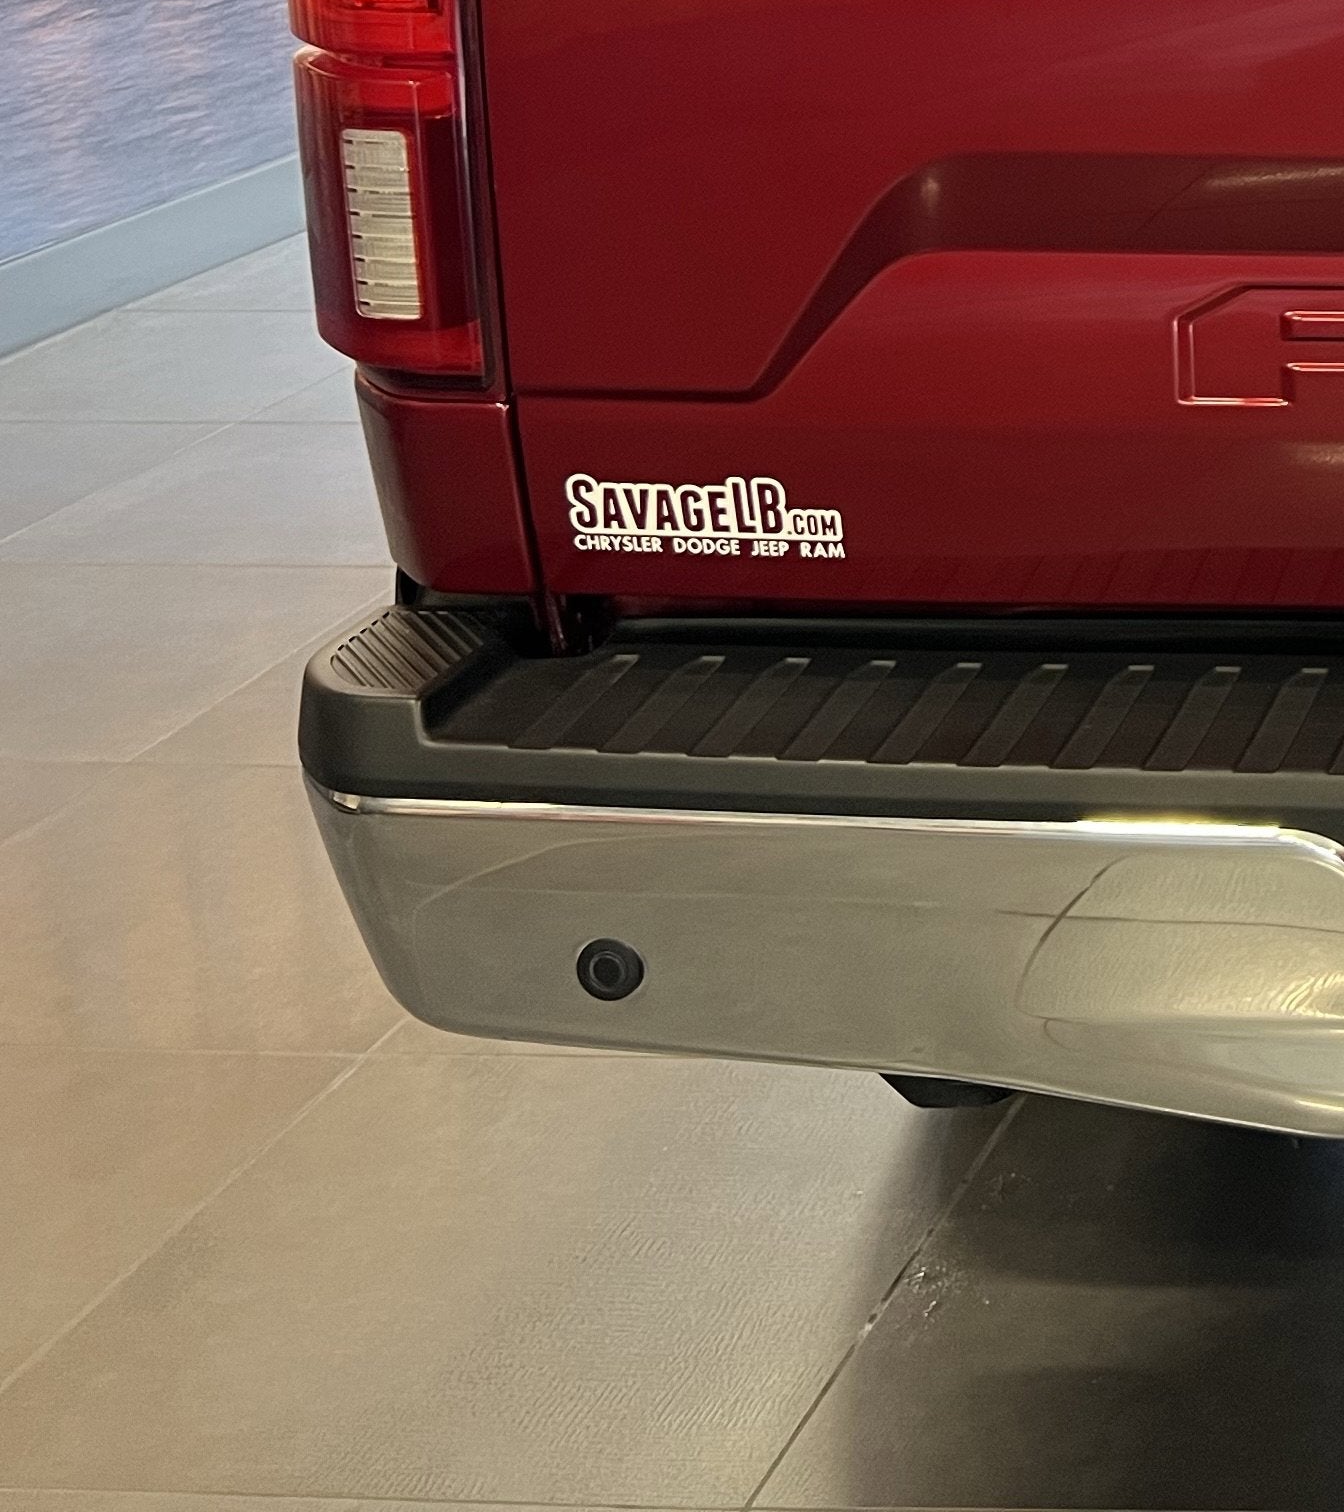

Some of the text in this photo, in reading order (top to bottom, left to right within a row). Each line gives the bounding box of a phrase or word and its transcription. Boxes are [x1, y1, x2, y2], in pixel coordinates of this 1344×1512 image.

[573, 534, 846, 559] CHRYSLER DODGE JEEP RAM
